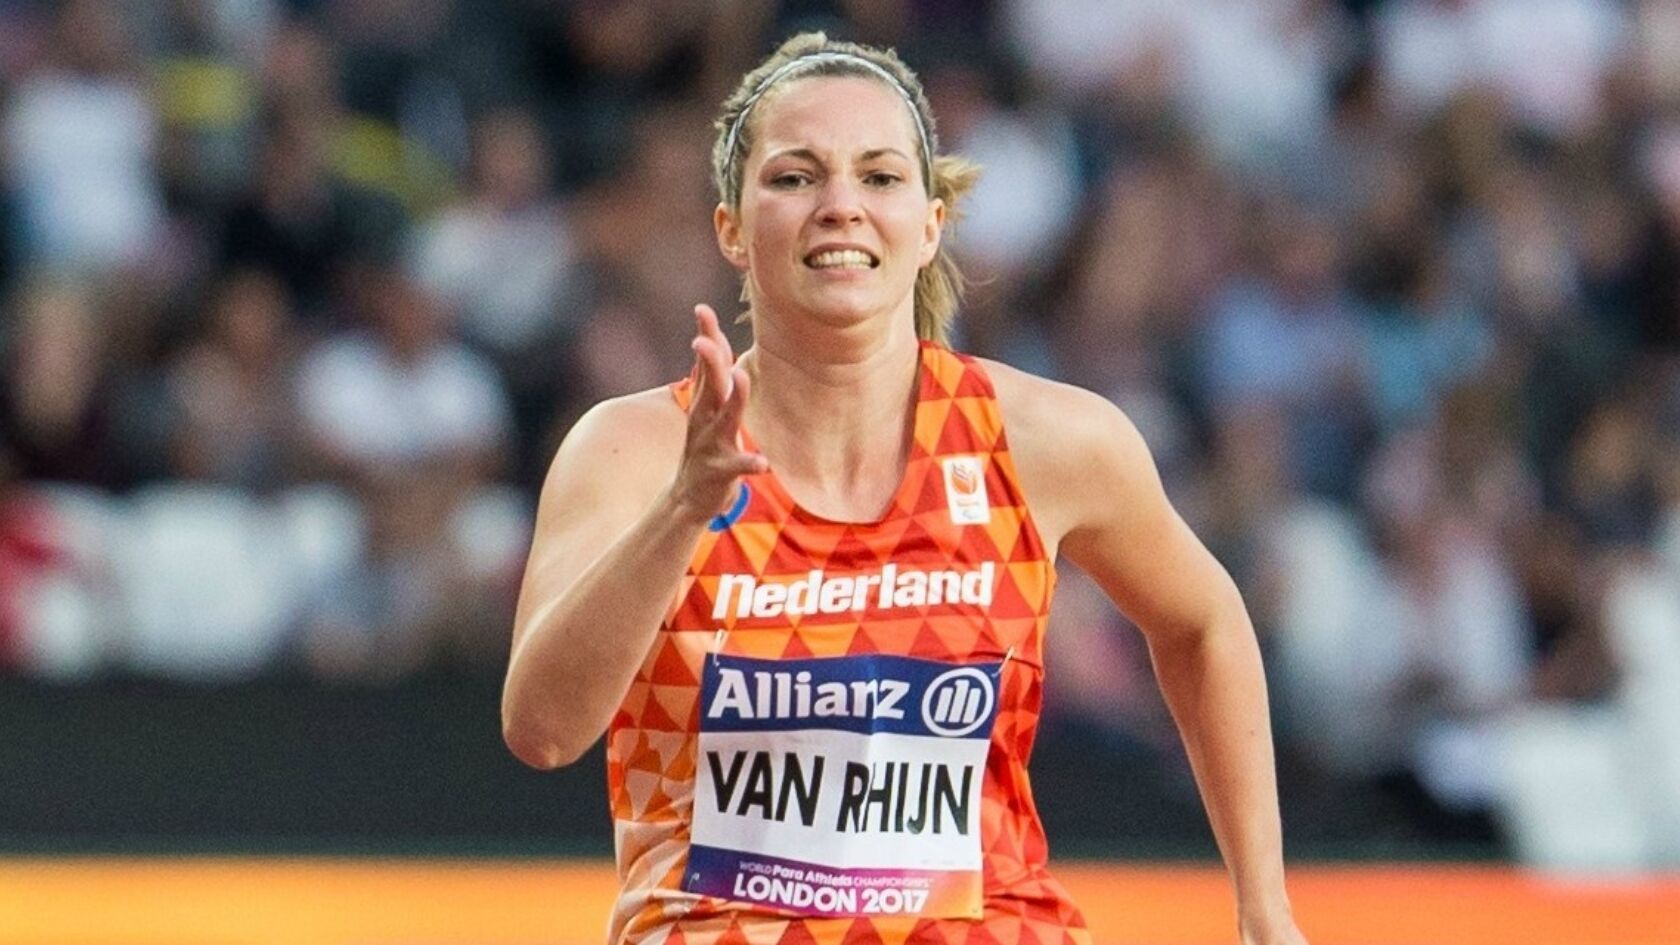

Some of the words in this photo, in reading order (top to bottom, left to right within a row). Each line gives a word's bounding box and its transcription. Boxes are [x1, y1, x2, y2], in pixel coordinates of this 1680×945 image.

[707, 668, 910, 720] Allianz
[706, 751, 825, 827] VAN
[836, 760, 974, 835] RHIJN
[733, 873, 857, 912] LONDON
[861, 888, 929, 914] 2017
[740, 861, 772, 875] WORLD
[772, 864, 803, 880] Para
